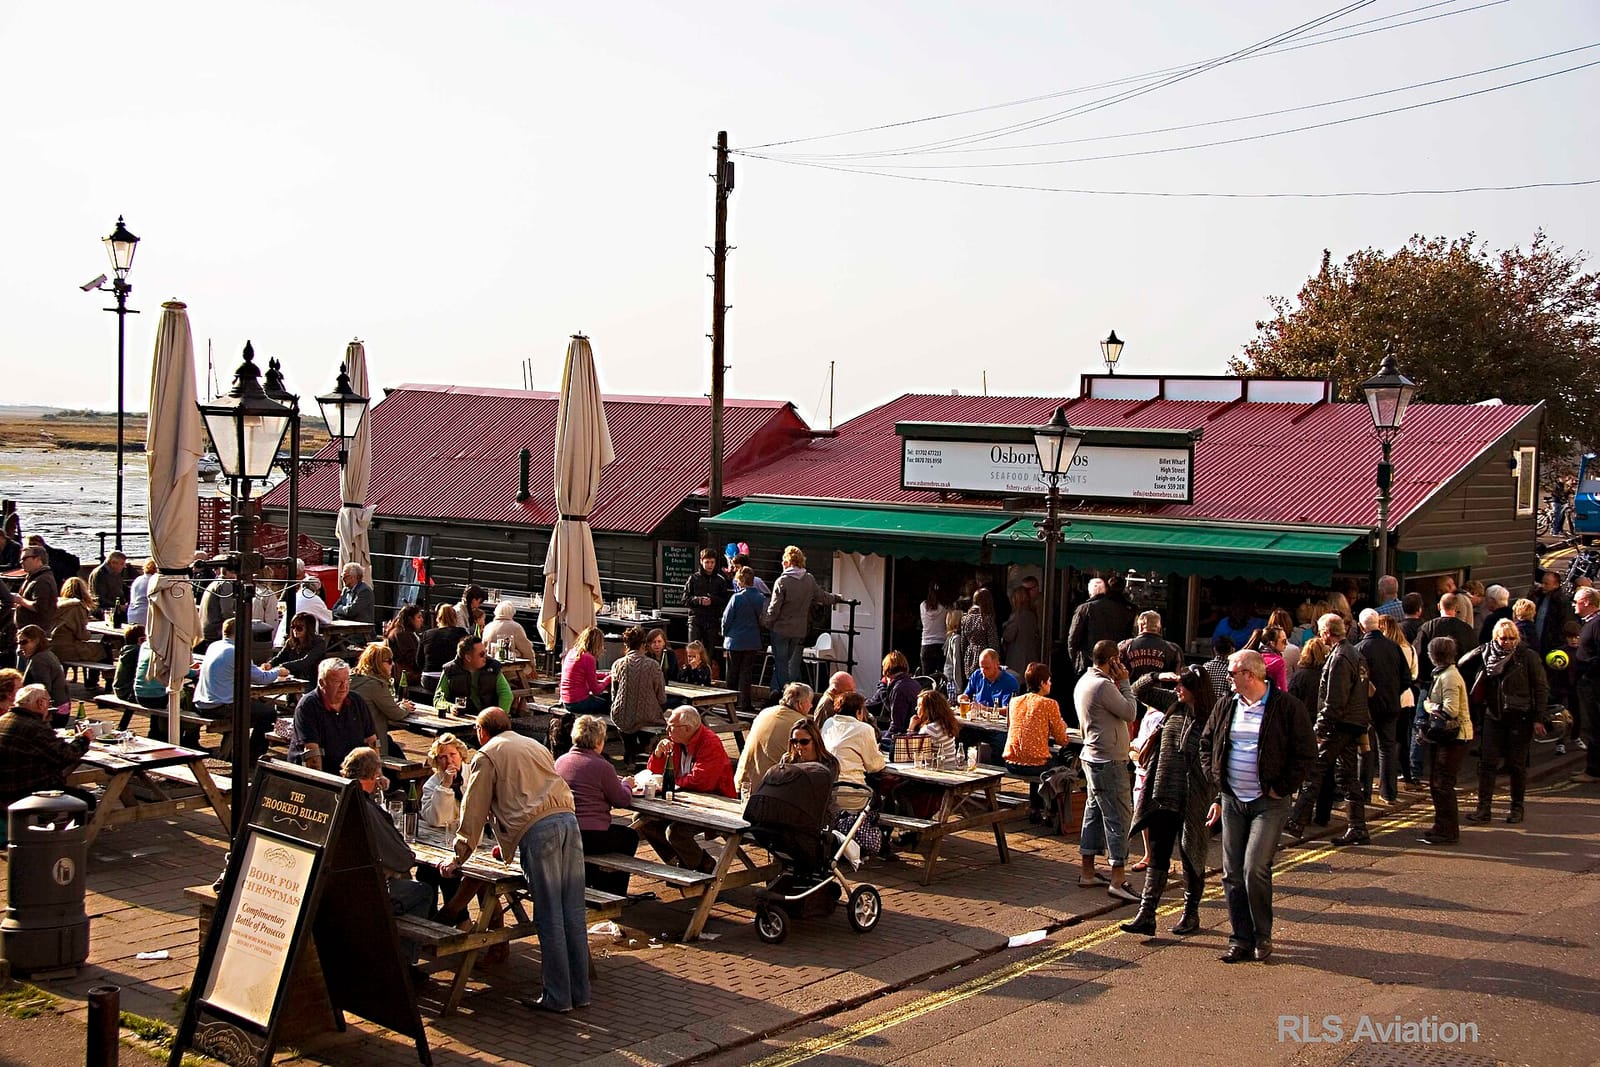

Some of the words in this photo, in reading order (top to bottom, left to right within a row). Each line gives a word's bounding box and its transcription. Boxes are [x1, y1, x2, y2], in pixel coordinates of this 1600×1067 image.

[990, 471, 1029, 481] SEAFOOD
[290, 791, 306, 804] THE
[299, 807, 329, 824] BILLET
[248, 866, 278, 887] BOOK
[278, 876, 300, 893] FOR
[241, 902, 287, 928] Complimentary
[235, 914, 254, 929] Bottle
[253, 921, 261, 932] of
[260, 924, 286, 940] Prosecco
